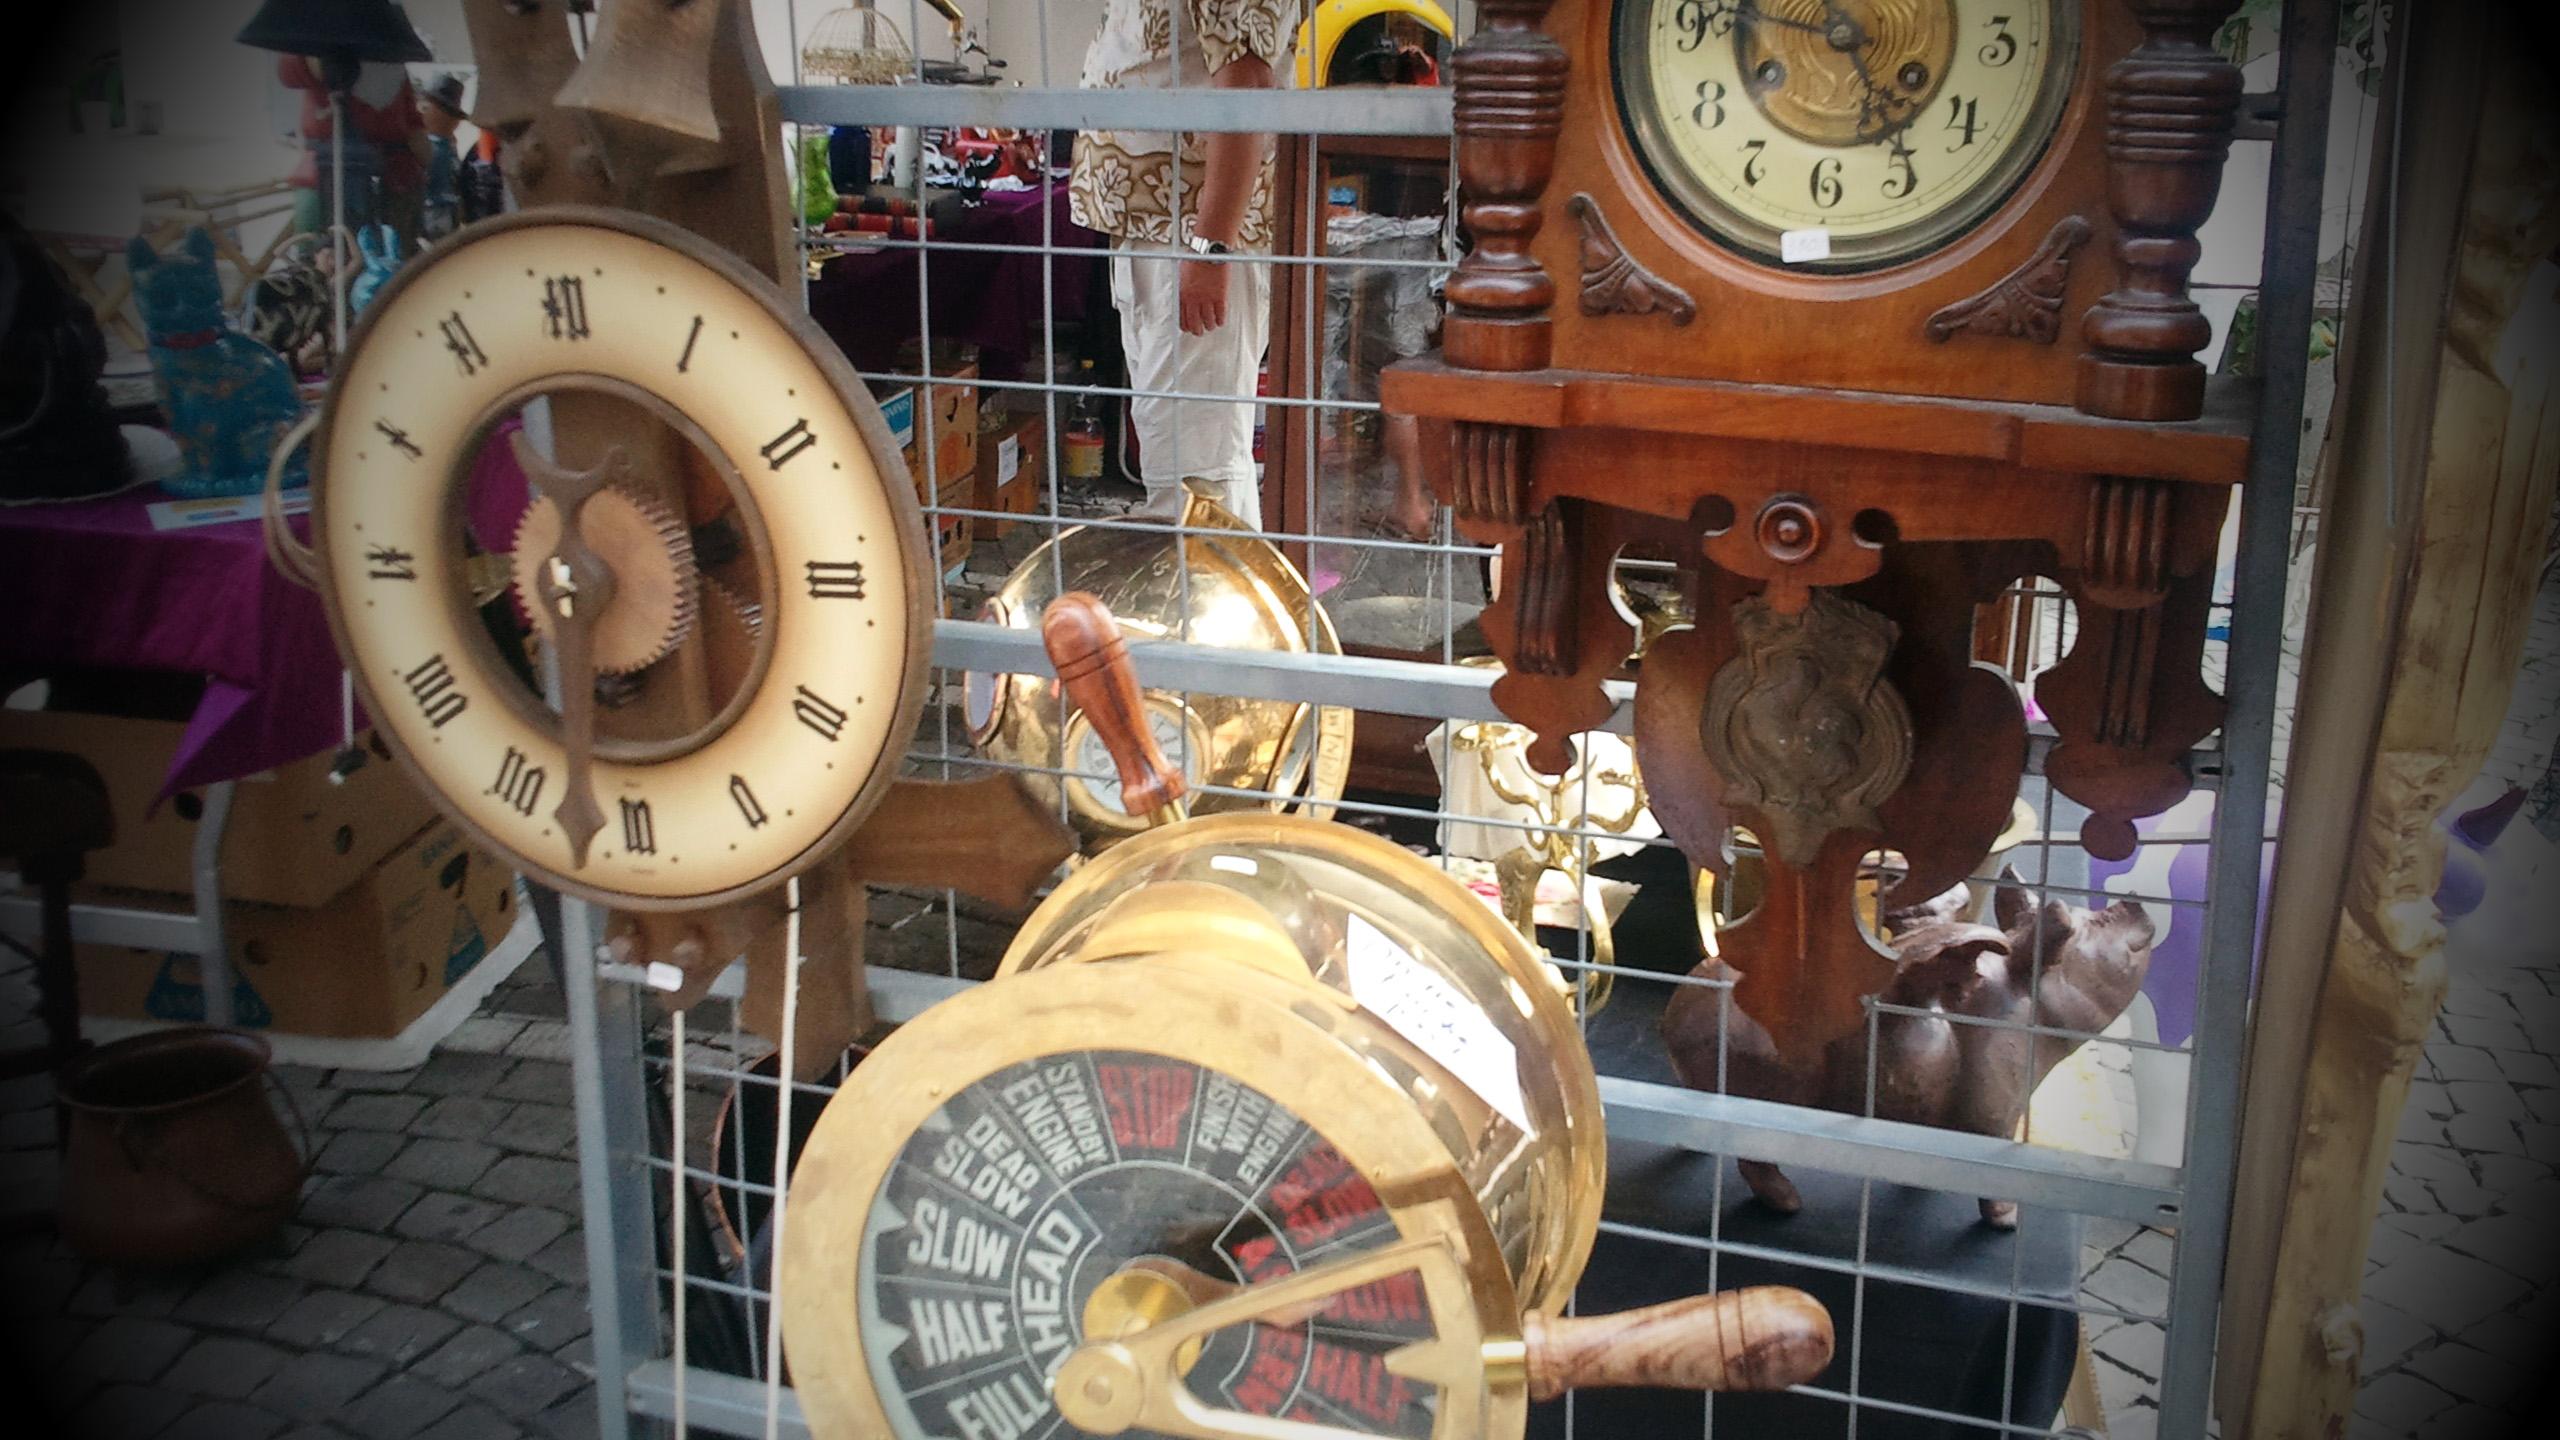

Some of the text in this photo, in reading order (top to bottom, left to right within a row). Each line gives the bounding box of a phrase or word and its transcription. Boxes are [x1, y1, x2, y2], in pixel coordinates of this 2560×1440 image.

[1978, 15, 2017, 67] 3
[1692, 80, 1725, 130] 8
[1944, 94, 1988, 153] 4
[1737, 139, 1766, 189] 7
[1809, 157, 1843, 208] 6
[1881, 148, 1918, 199] 5
[542, 274, 590, 341] XII
[678, 314, 704, 374] I
[760, 417, 817, 471] II
[804, 560, 865, 600] III
[728, 772, 769, 830] V
[1003, 1072, 1084, 1177] ENGINE
[1047, 1061, 1109, 1163] STANDBY
[1097, 1065, 1193, 1149] STOP
[1221, 1087, 1269, 1154] WITH
[933, 1134, 1033, 1219] SLOW
[964, 1114, 1042, 1191] DEAD
[1236, 1102, 1299, 1186] ENGIN
[907, 1197, 1010, 1281] SLOW
[909, 1299, 1008, 1369] HALF
[946, 1372, 1053, 1440] FULL
